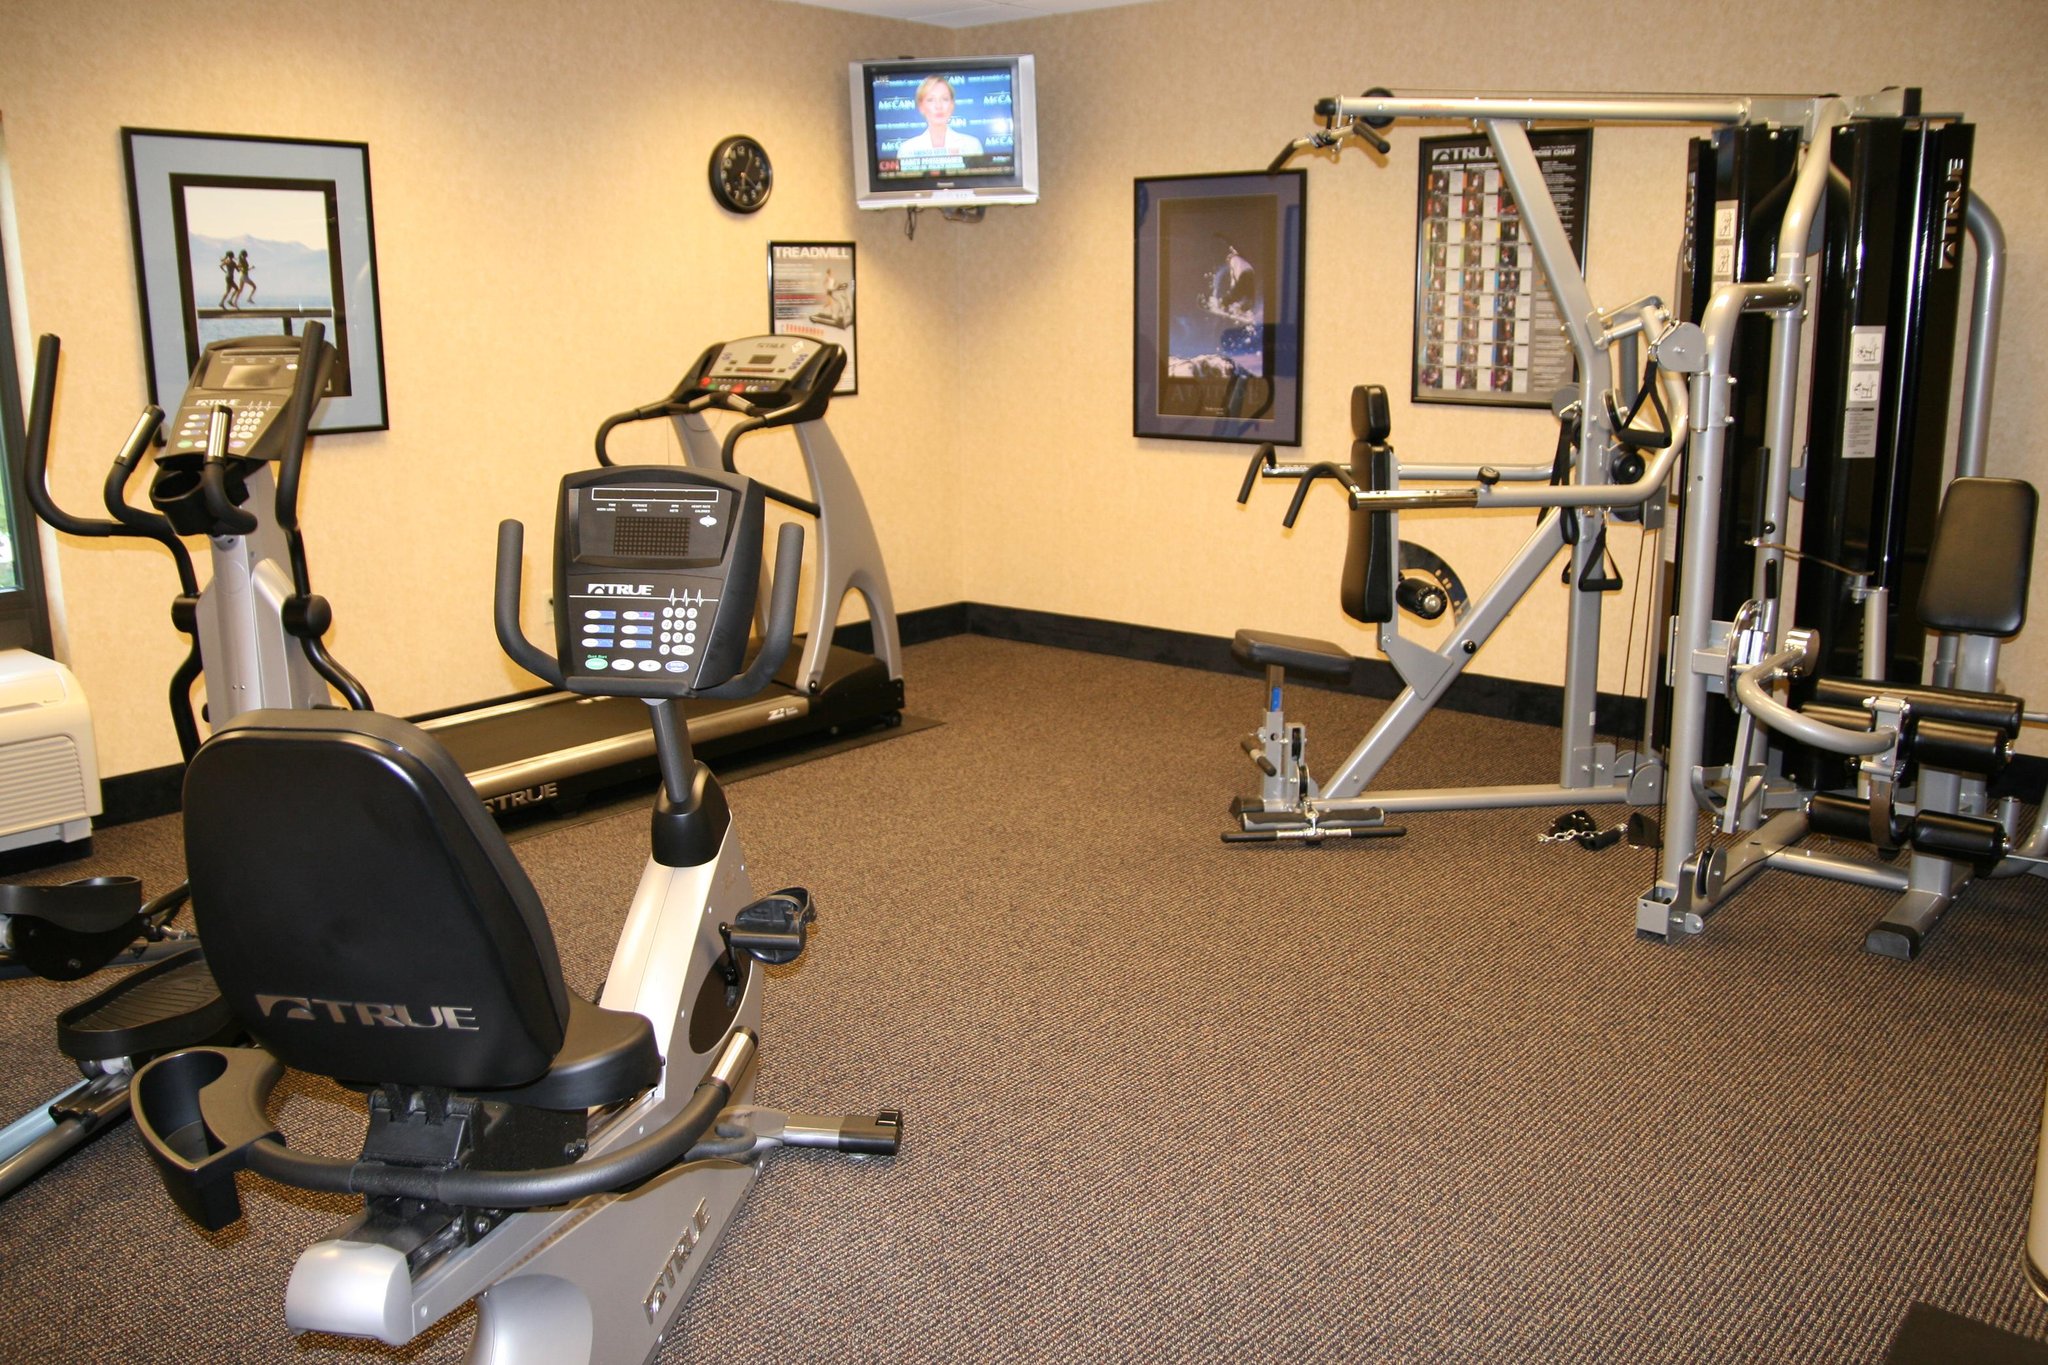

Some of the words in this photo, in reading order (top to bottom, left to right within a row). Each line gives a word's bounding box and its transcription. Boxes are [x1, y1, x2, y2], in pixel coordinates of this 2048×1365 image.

[879, 160, 899, 171] CNN
[1943, 159, 1964, 241] TRUE
[775, 246, 849, 259] TREADMILL
[604, 584, 655, 595] TRUE
[494, 782, 558, 810] TRUE
[311, 998, 479, 1030] TRUE
[663, 1197, 711, 1290] TRUE
